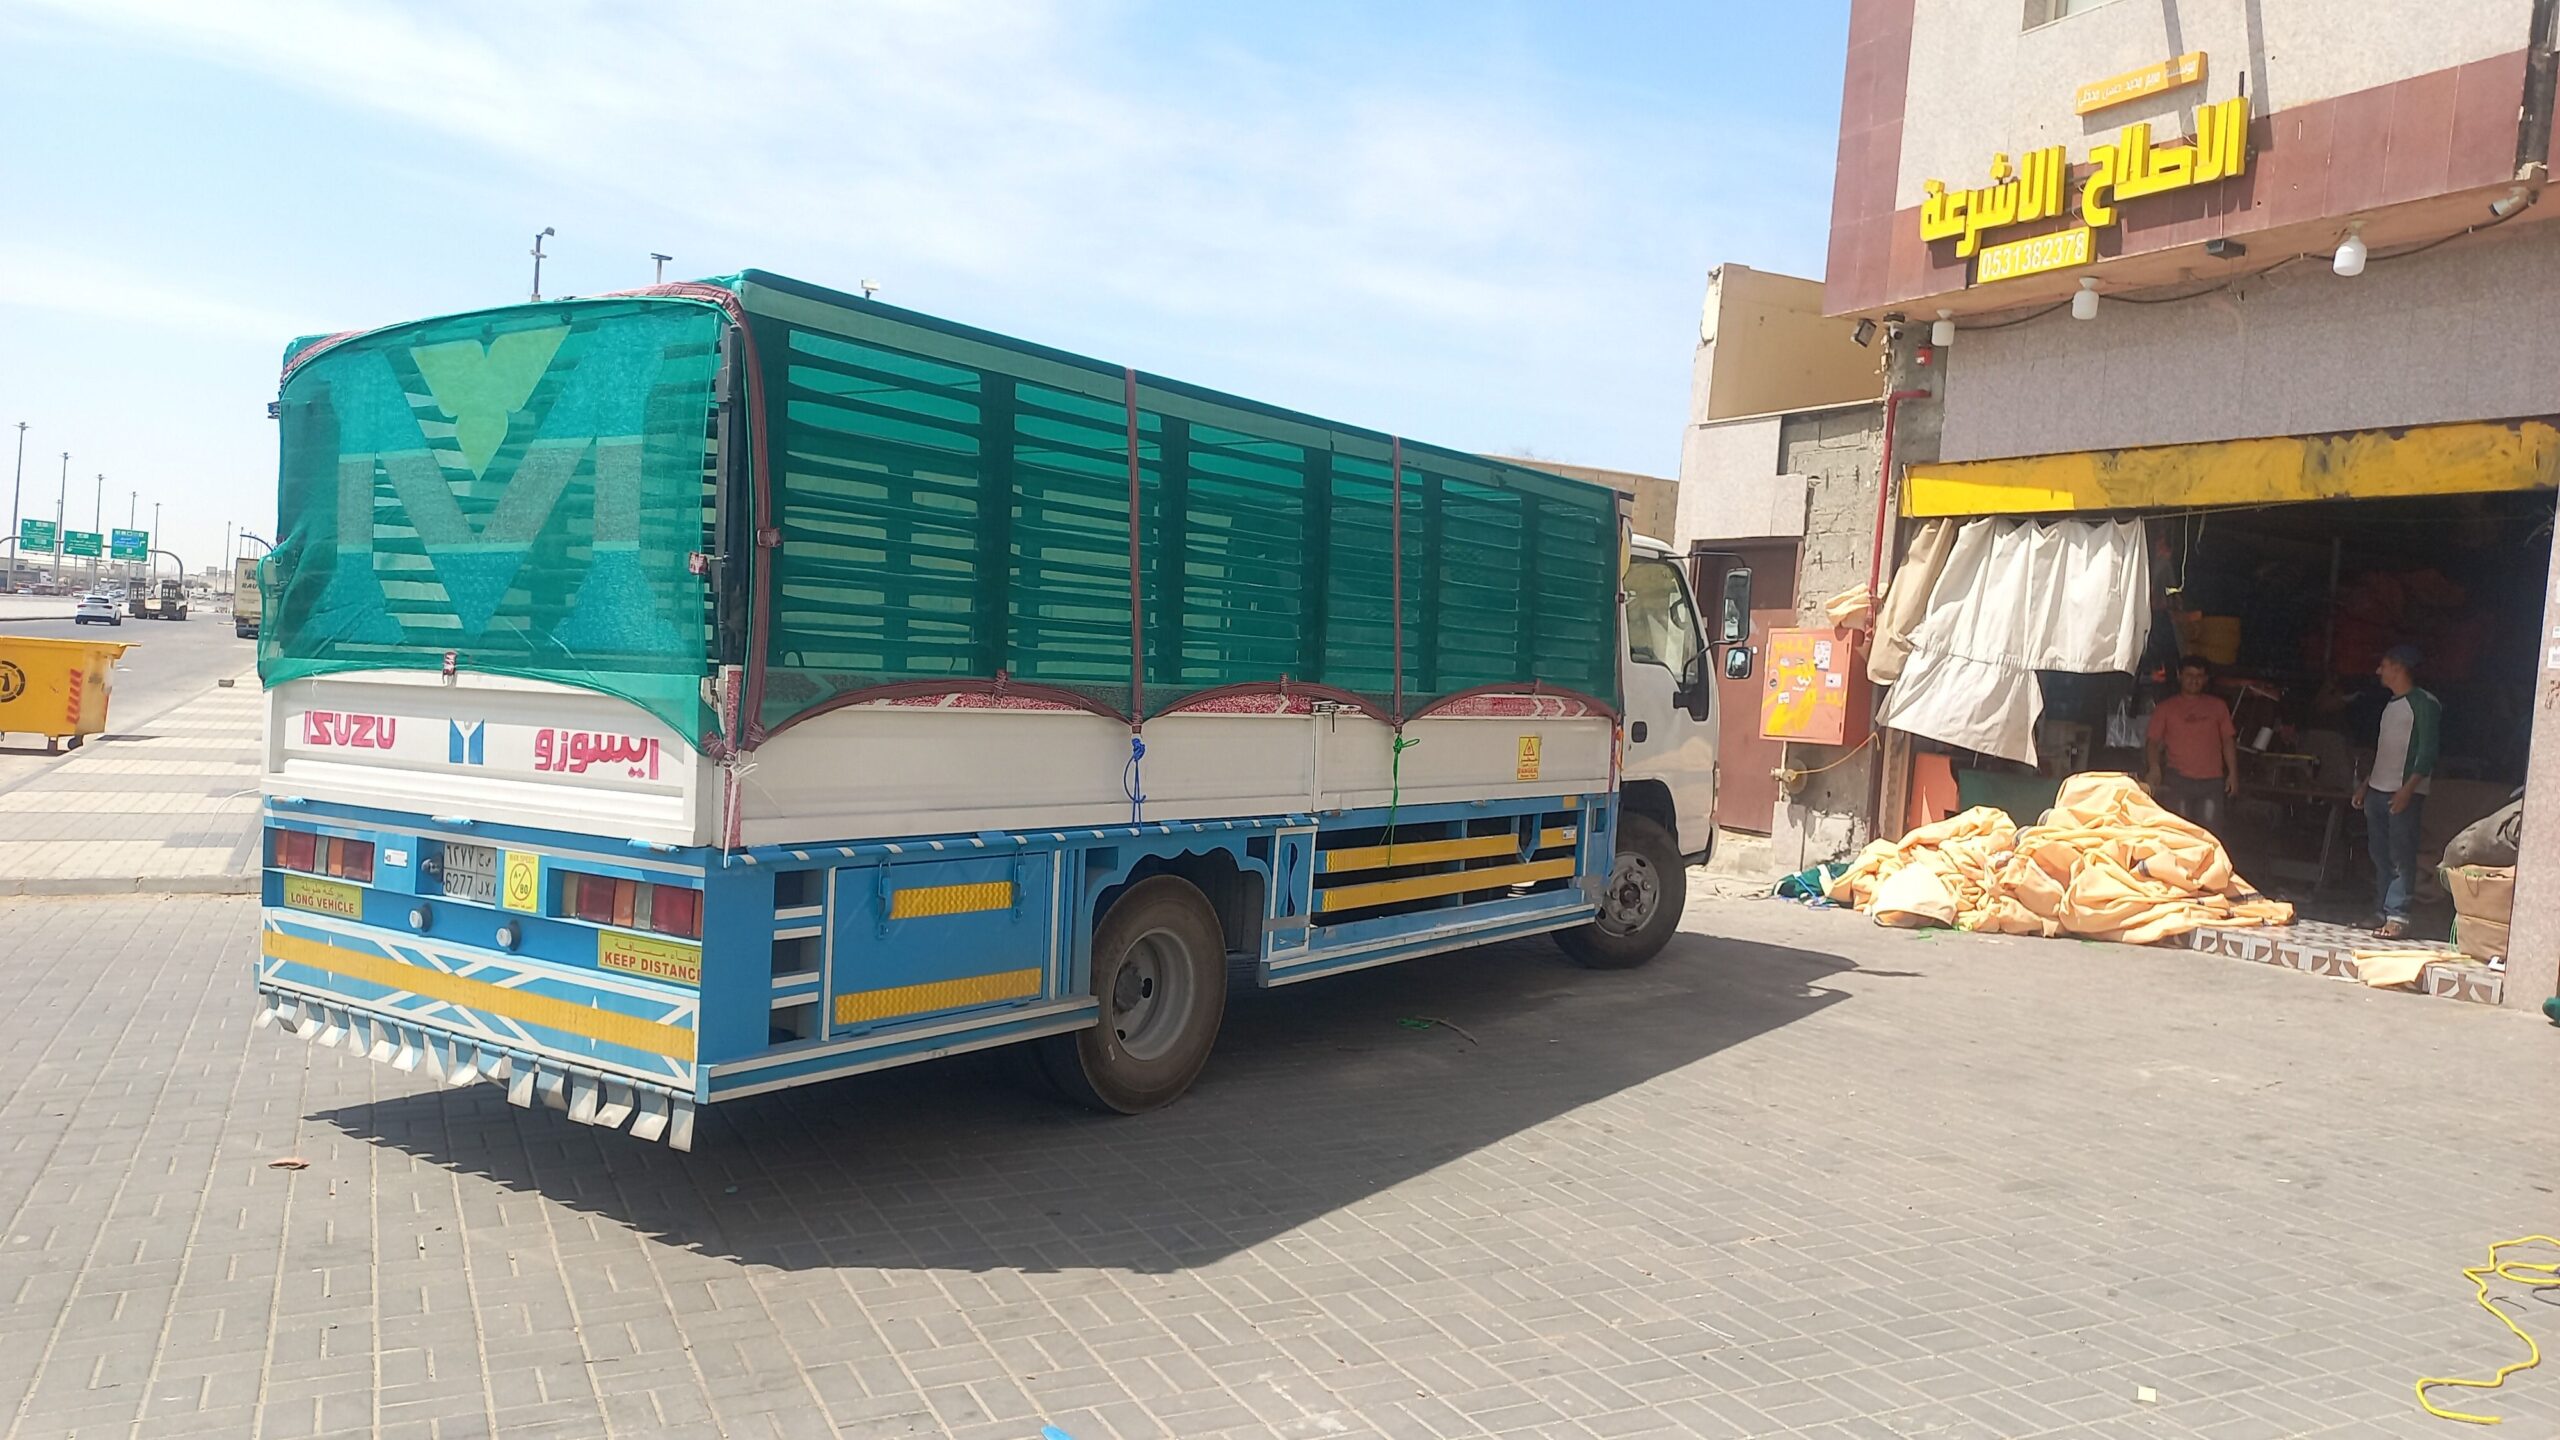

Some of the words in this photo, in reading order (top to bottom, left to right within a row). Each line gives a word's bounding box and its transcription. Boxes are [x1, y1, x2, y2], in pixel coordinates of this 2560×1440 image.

[1981, 231, 2086, 280] 0531382378
[303, 711, 396, 750] ISUZU
[445, 872, 473, 897] 6277
[290, 892, 314, 907] LONG
[317, 897, 355, 914] VEHICLE
[604, 951, 636, 969] KEEP
